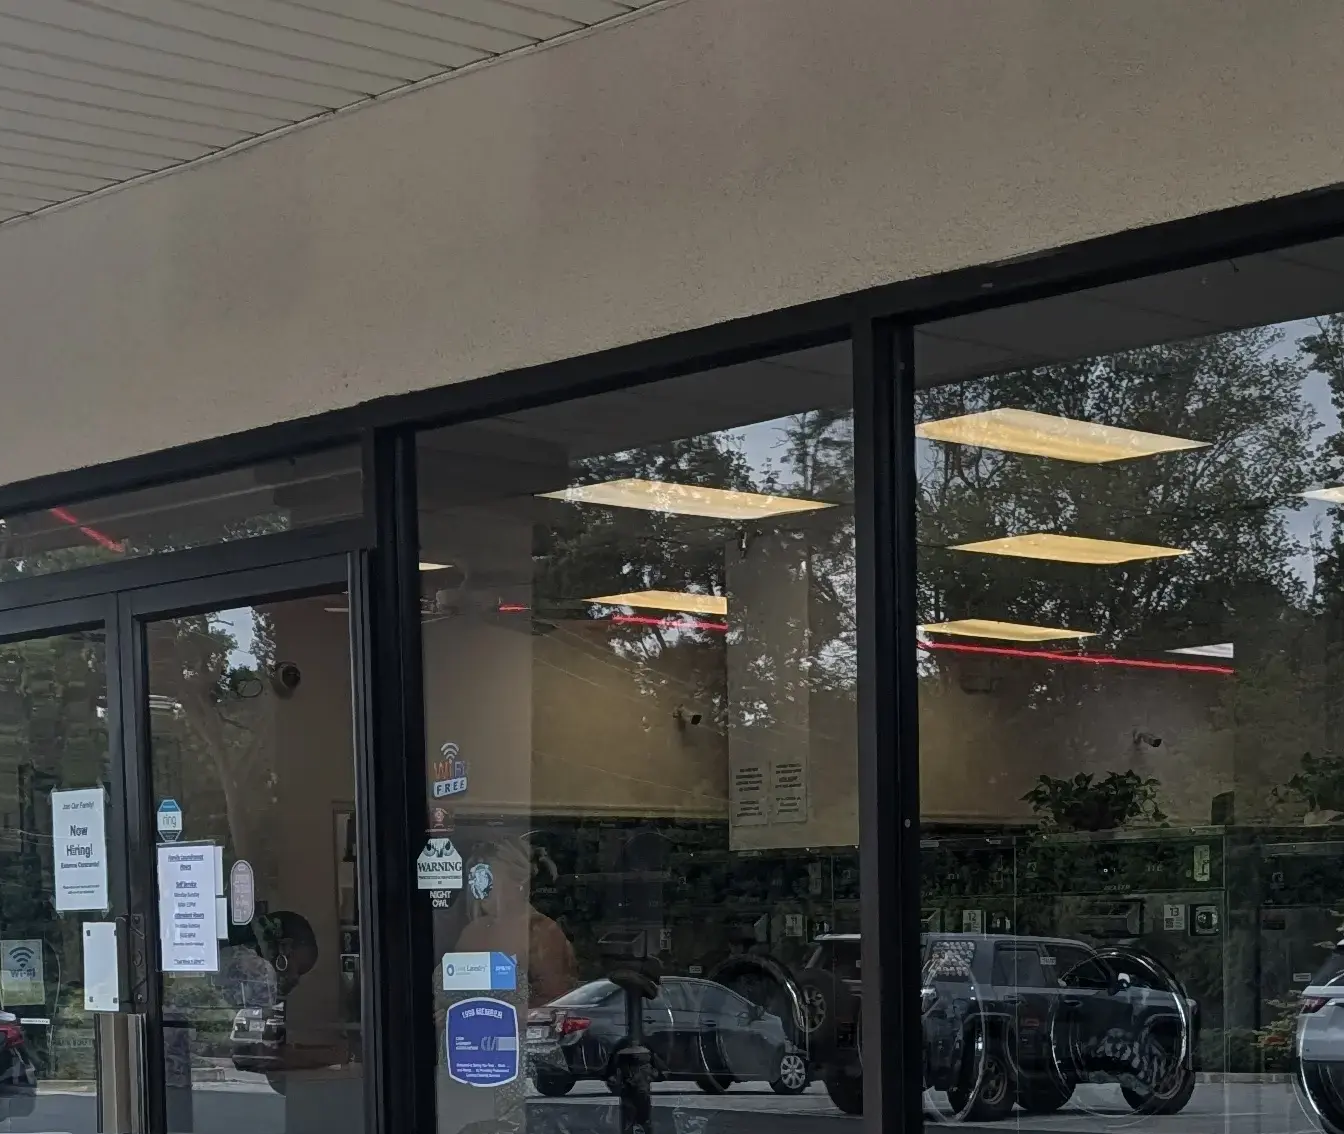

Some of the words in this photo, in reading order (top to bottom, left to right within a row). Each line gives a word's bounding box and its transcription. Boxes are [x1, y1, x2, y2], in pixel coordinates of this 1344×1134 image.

[436, 780, 465, 796] FREE
[162, 814, 177, 829] ring
[70, 824, 88, 836] Now
[66, 843, 93, 858] Hiring!
[417, 861, 462, 872] WARNING
[429, 890, 451, 899] NIGHT
[432, 899, 449, 908] OWL
[1169, 907, 1180, 917] 13
